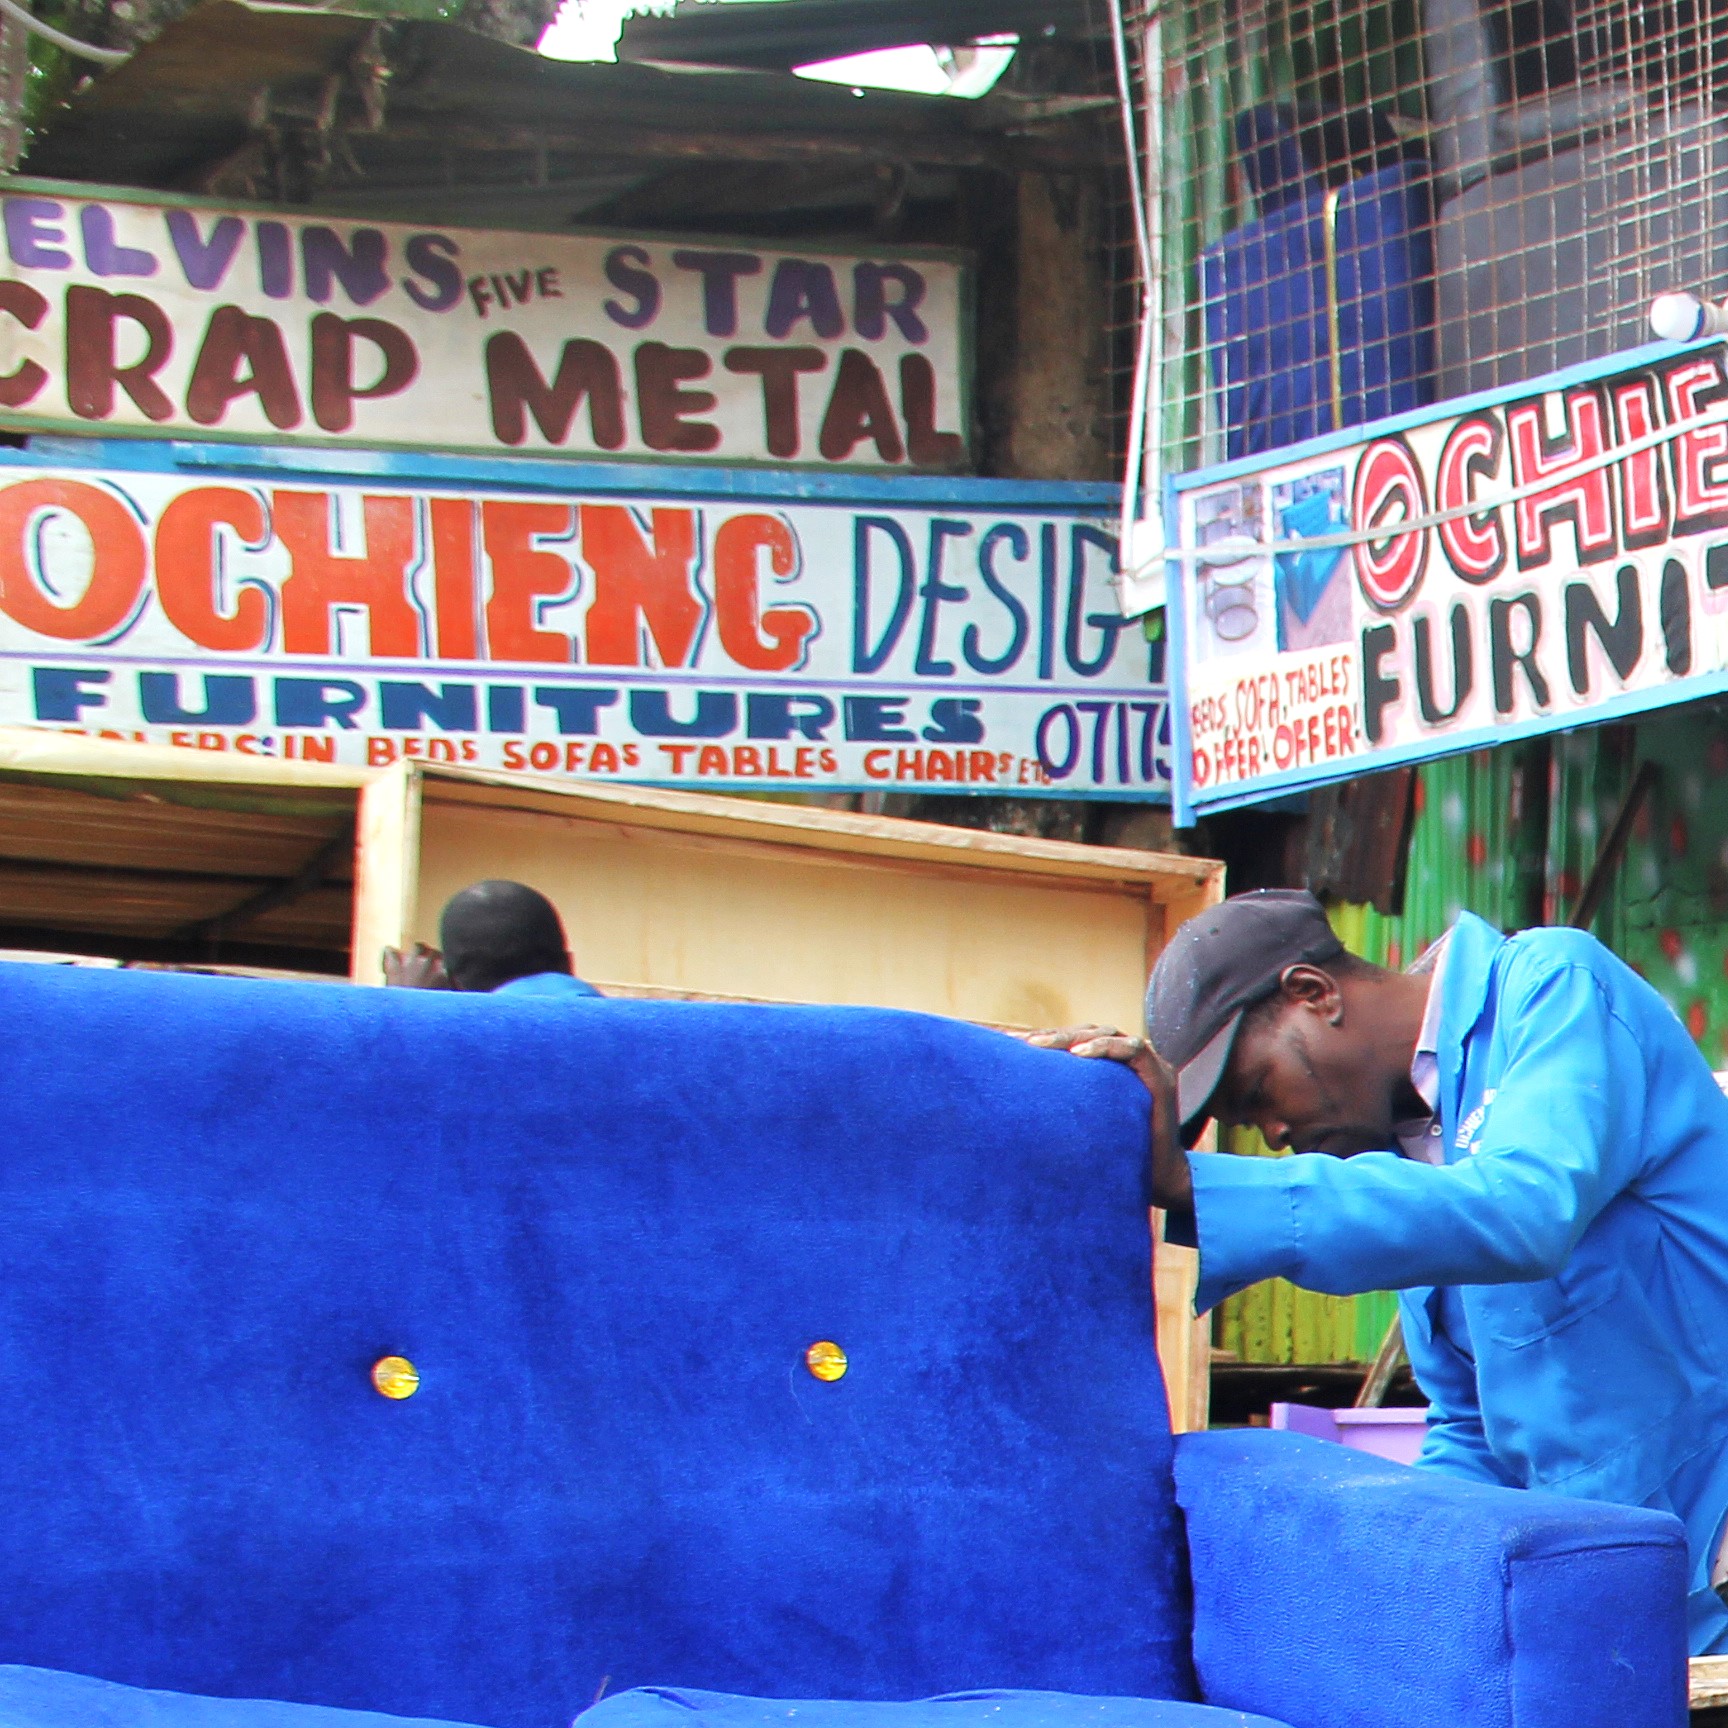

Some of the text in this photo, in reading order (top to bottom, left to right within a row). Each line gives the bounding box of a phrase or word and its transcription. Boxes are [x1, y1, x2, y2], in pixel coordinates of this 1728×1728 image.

[2, 198, 930, 345] ELVINS FIVE STAR
[0, 277, 964, 467] CRAP METAL
[0, 477, 819, 672] OCHIENG
[32, 667, 986, 744] FURNITURES
[1285, 653, 1352, 708] TABLES
[502, 740, 640, 774] SOFAS
[658, 744, 838, 778] TABLES
[863, 749, 1013, 783] CHAIRS
